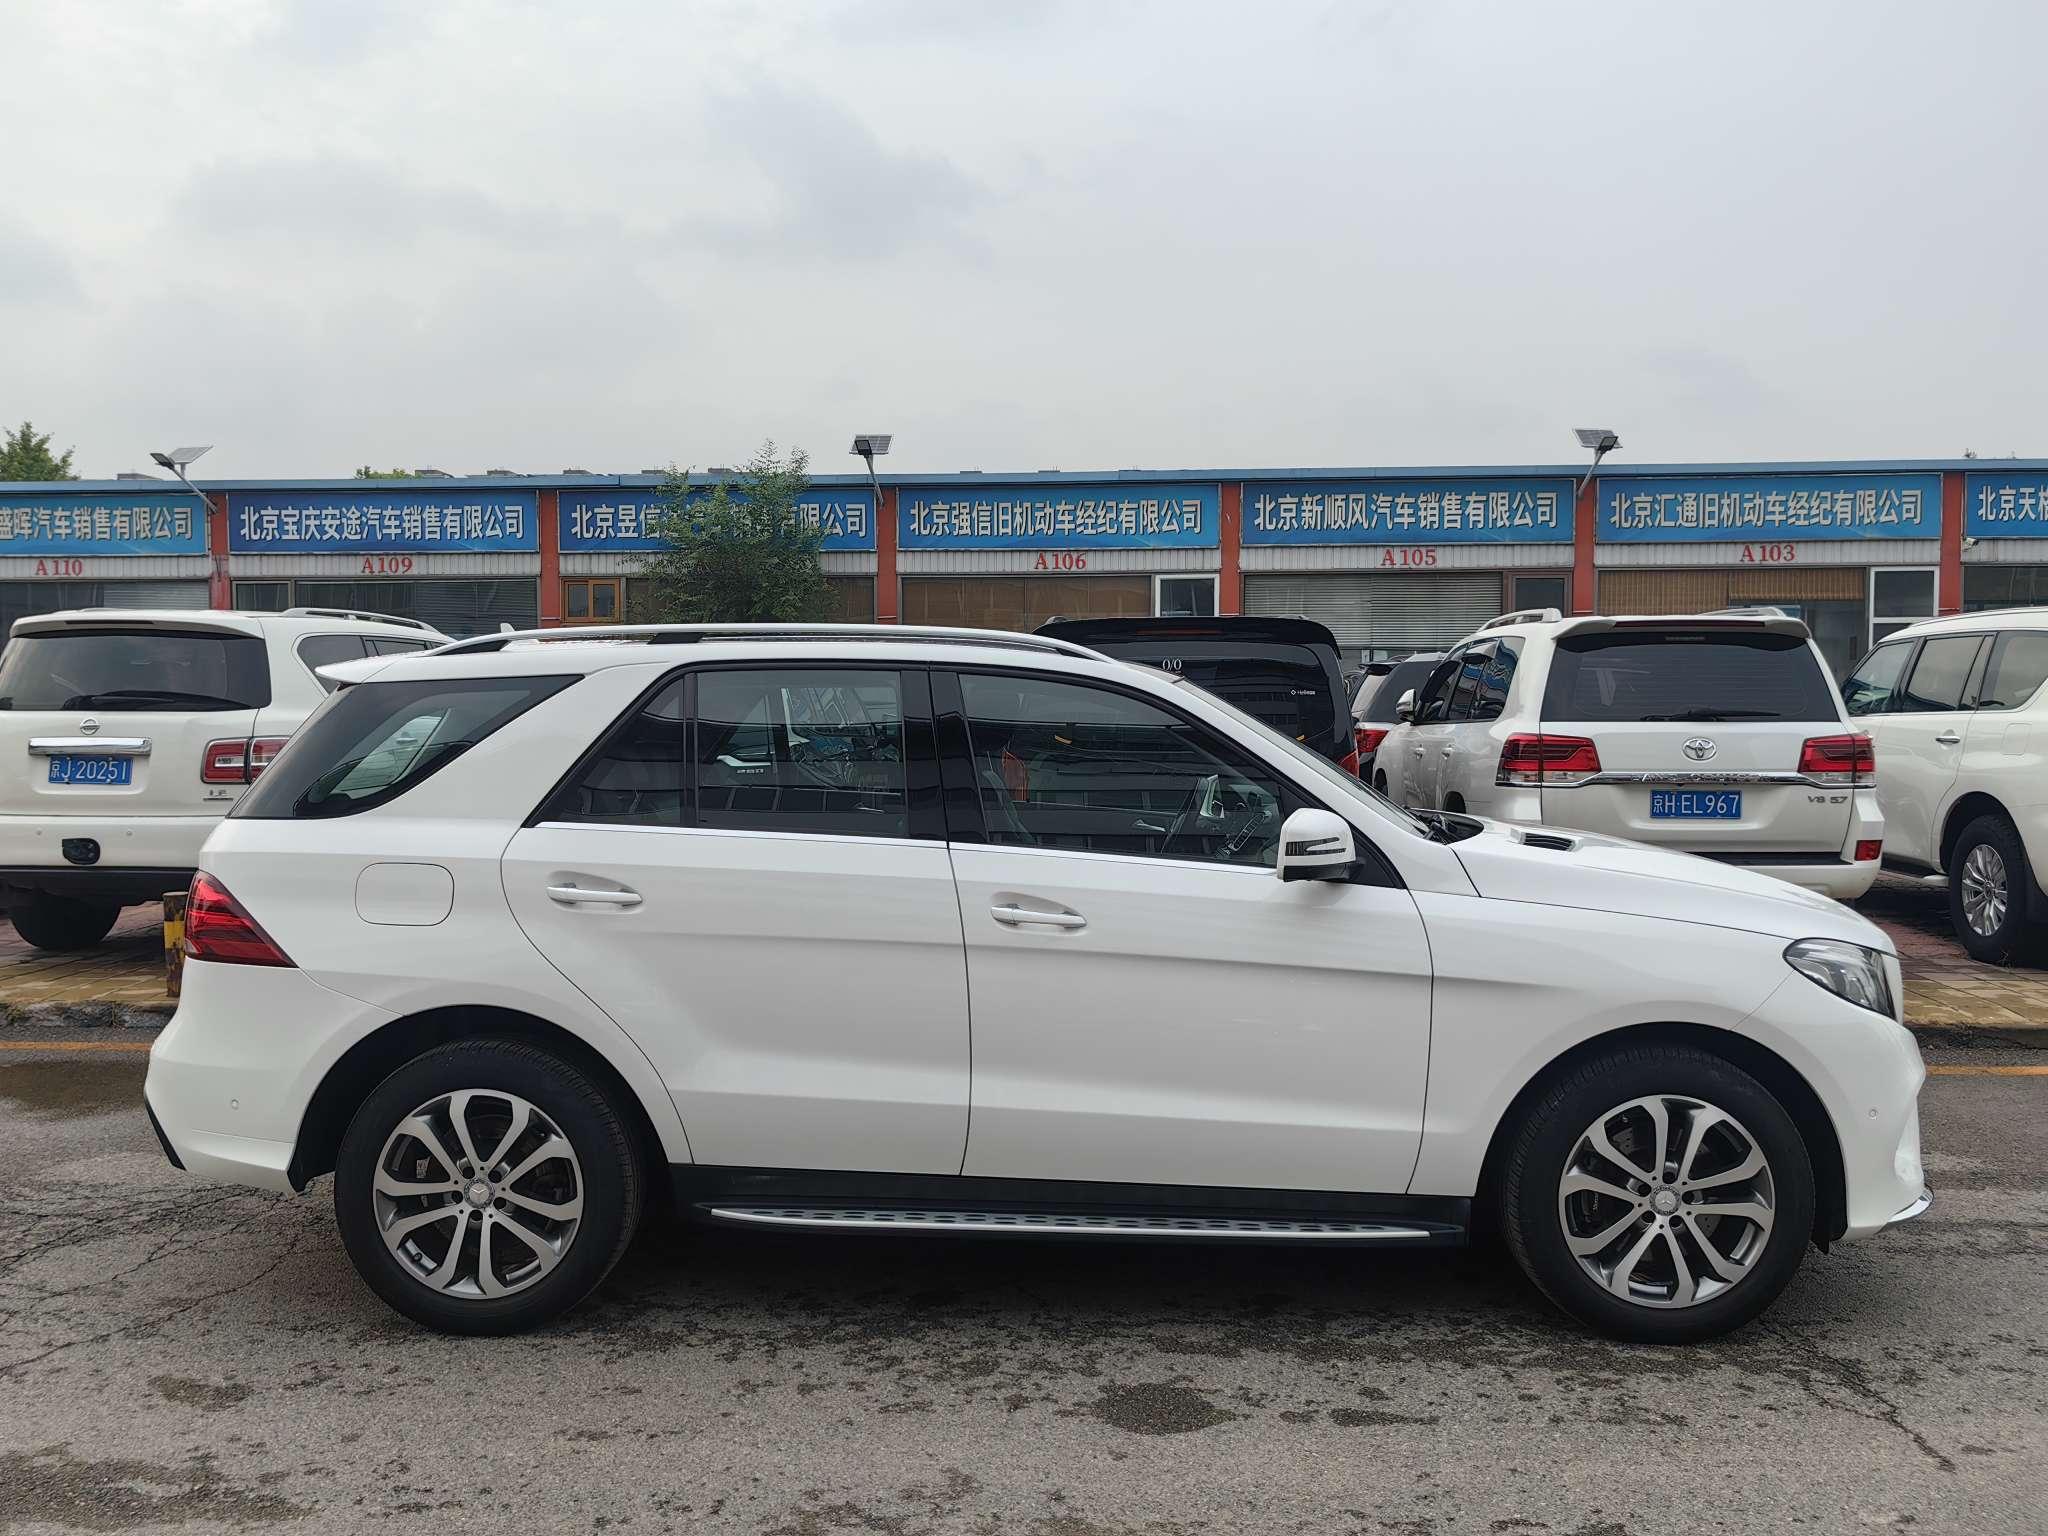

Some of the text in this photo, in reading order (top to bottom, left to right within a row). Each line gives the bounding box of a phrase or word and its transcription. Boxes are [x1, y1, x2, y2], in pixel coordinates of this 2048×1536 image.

[910, 499, 1201, 536] 北京强信旧机动车经纪有限公司
[1254, 491, 1557, 531] 北京新顺风汽车销售有限公司
[1610, 489, 1922, 529] 北京汇通旧机动车经纪有限公司
[240, 505, 524, 541] 北京宝庆安途汽车销售有限公司
[361, 557, 413, 574] A109
[1034, 552, 1087, 570] A106
[1380, 548, 1437, 567] A105
[1739, 543, 1795, 562] A103
